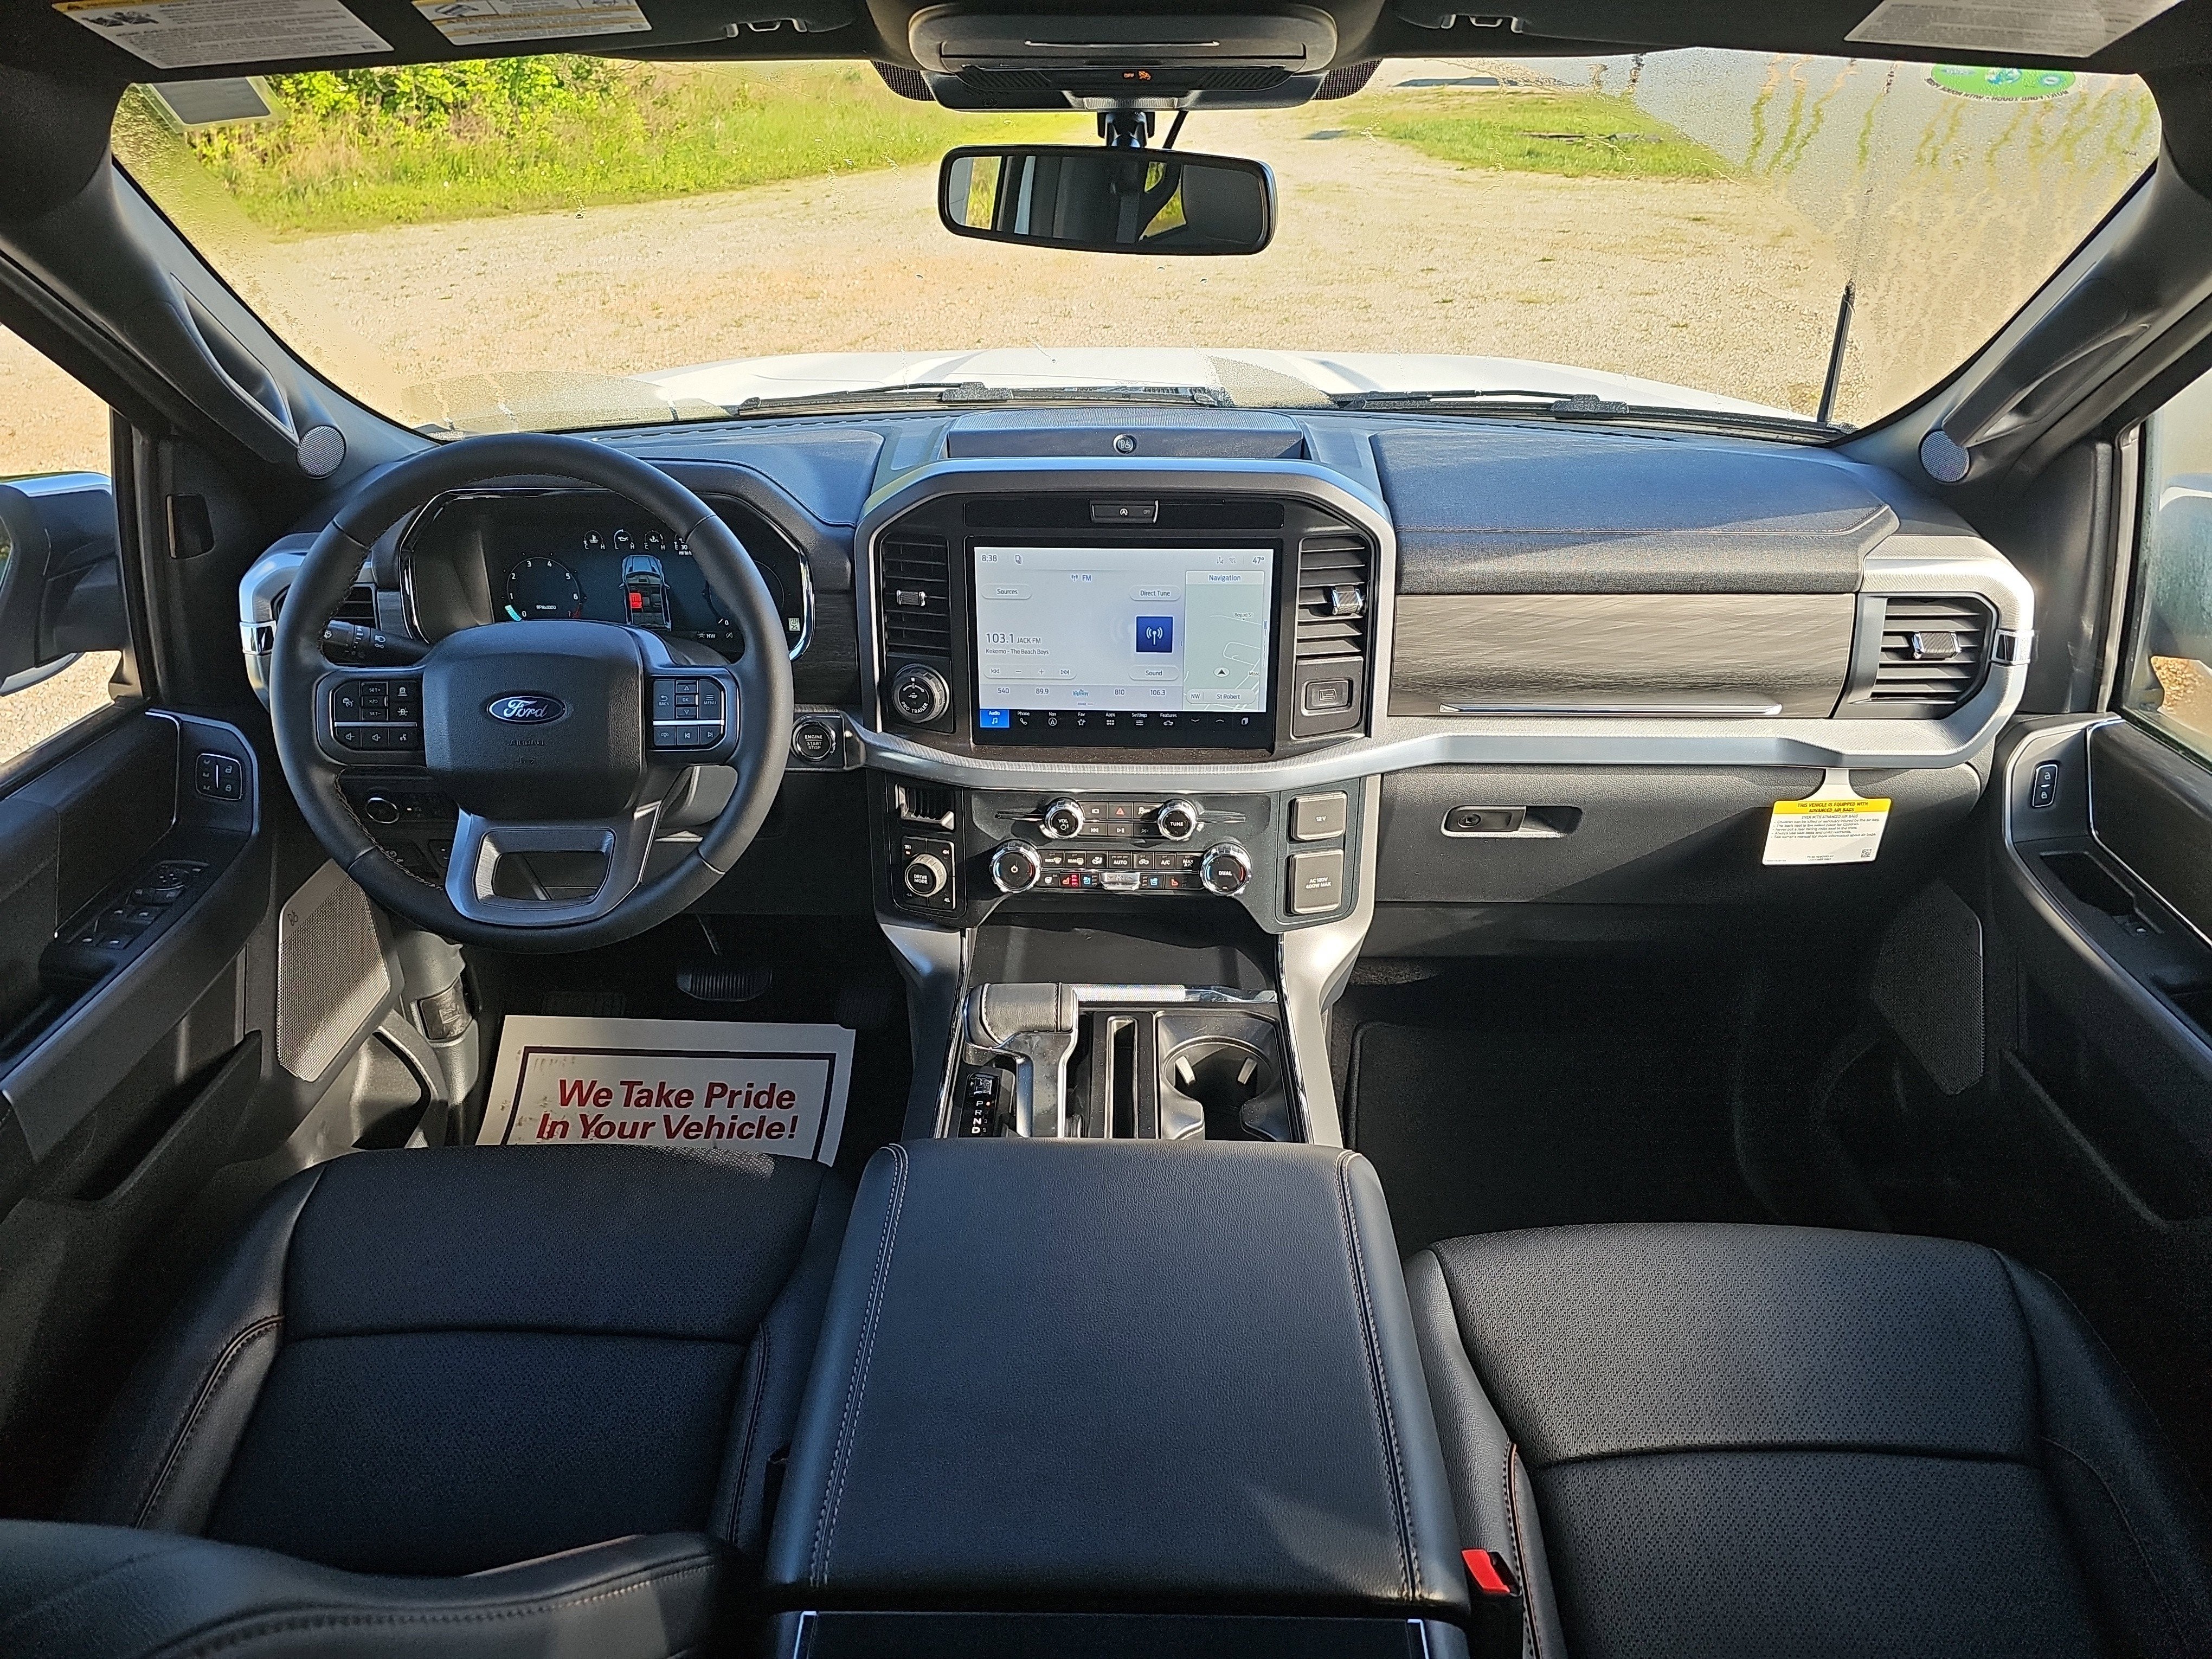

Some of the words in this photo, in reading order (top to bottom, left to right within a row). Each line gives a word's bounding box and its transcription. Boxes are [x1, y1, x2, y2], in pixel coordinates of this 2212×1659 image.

[986, 633, 1014, 644] 103.1
[503, 699, 548, 717] Ford
[901, 701, 910, 711] PRO
[911, 703, 928, 713] TRAILER
[558, 1079, 613, 1109] We
[619, 1081, 695, 1109] Take
[704, 1082, 797, 1110] Pride
[536, 1114, 569, 1140] In
[578, 1114, 655, 1140] Your
[662, 1114, 799, 1140] Vehicle!
